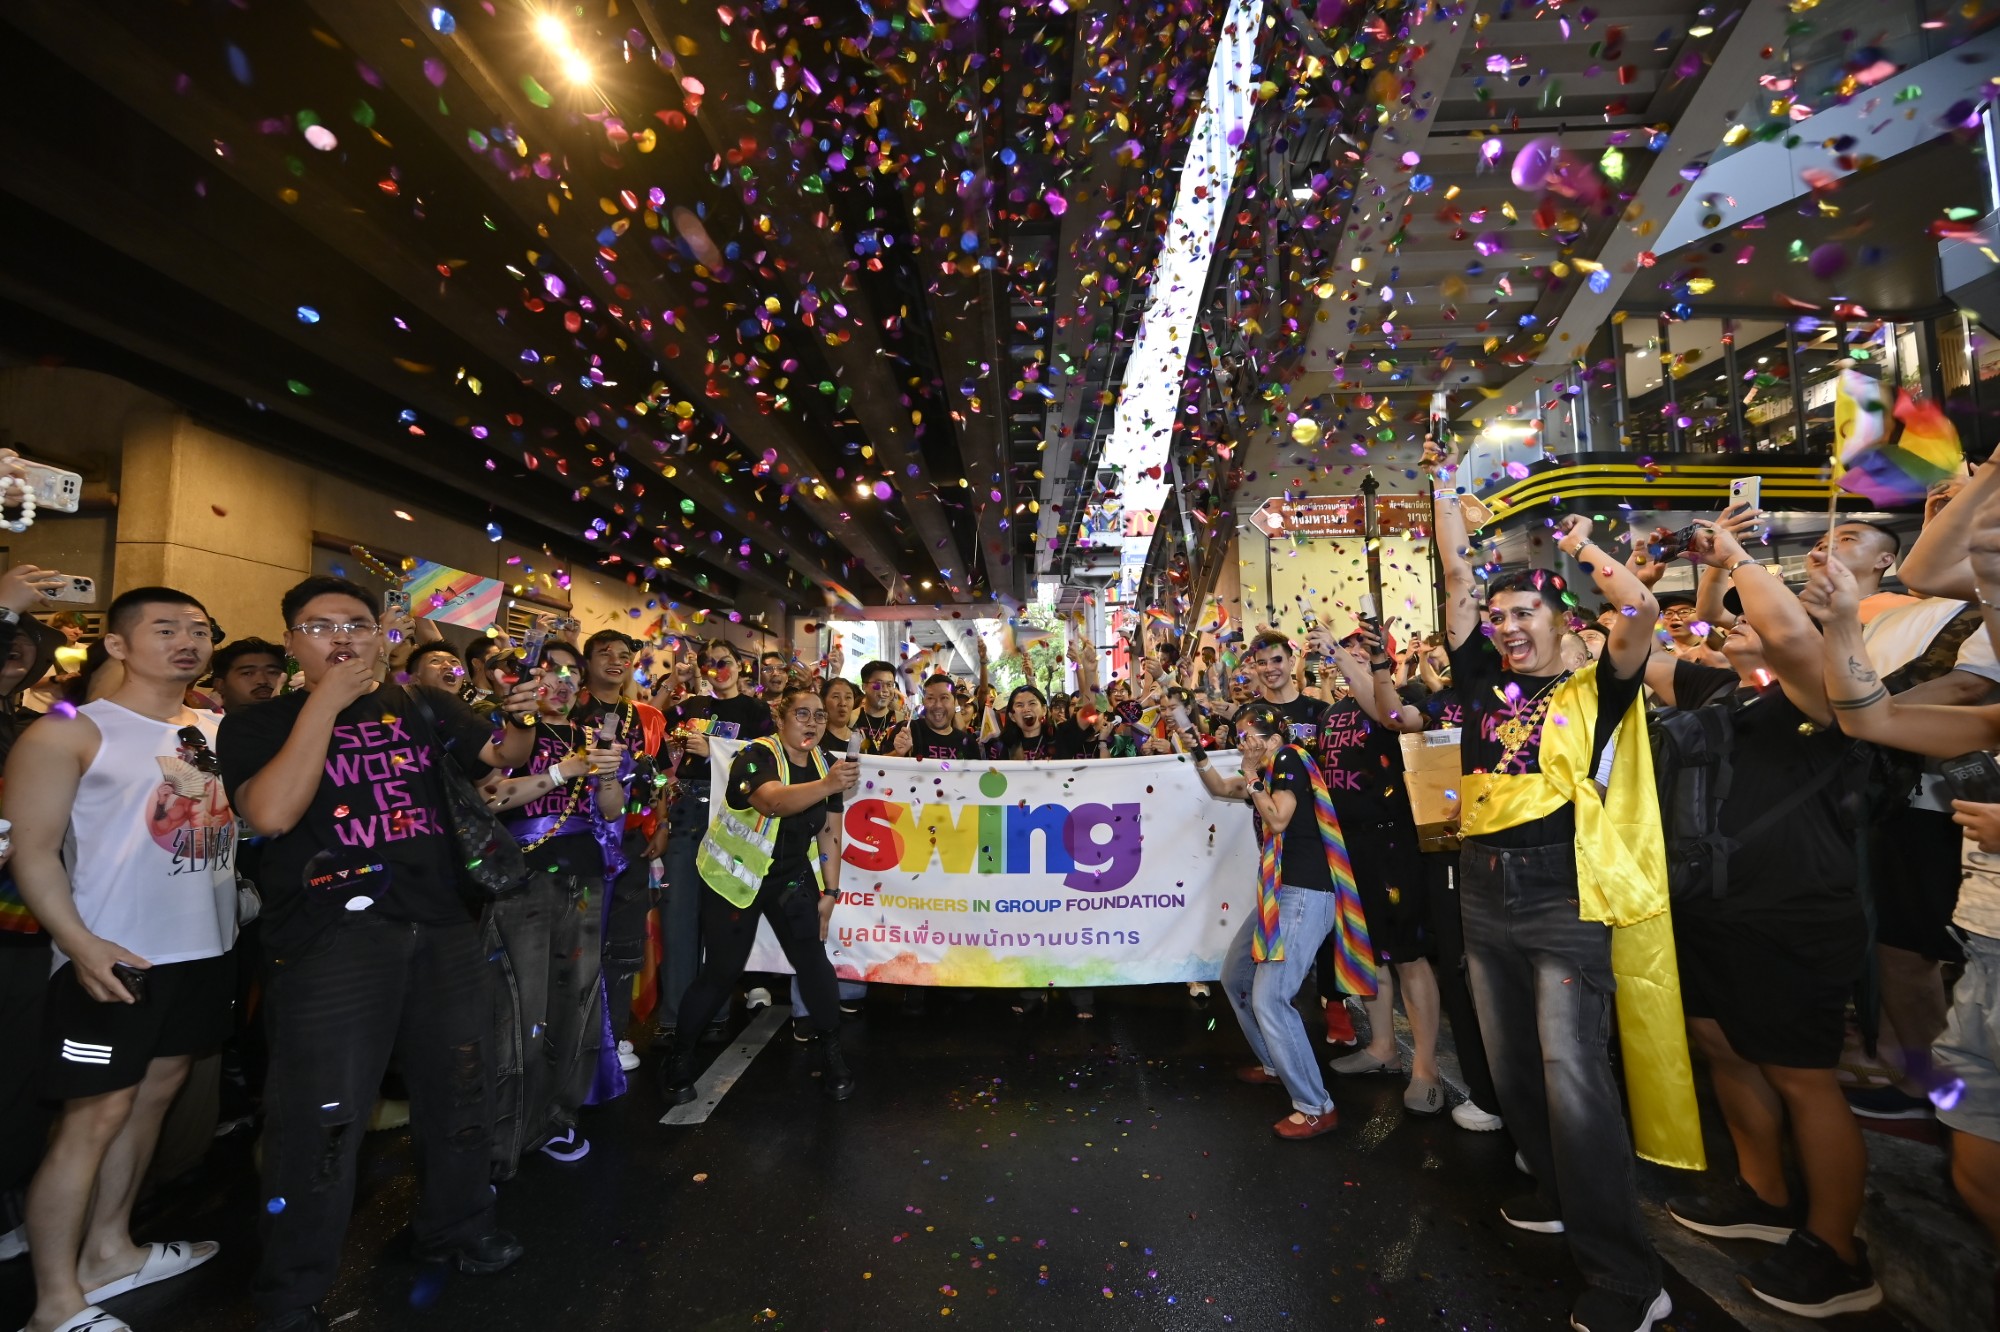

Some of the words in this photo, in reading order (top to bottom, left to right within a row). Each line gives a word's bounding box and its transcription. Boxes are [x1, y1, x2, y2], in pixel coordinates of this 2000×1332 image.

[1325, 710, 1360, 728] SEX
[333, 718, 411, 749] SEX
[928, 746, 957, 758] SEX
[1325, 750, 1341, 768] IS
[326, 745, 432, 787] WORK
[1954, 765, 1984, 780] 16:19
[1324, 769, 1361, 790] ORK
[373, 781, 412, 811] IS
[334, 808, 444, 848] WORK
[841, 771, 1142, 892] swing
[821, 891, 875, 906] VICE
[879, 893, 969, 912] WORKERS
[972, 899, 990, 912] IN
[995, 899, 1062, 913] GROUP
[1065, 894, 1185, 911] FOUNDATION
[839, 920, 1140, 947] มูลนิธิเพื่อนพนักงานบริการ
